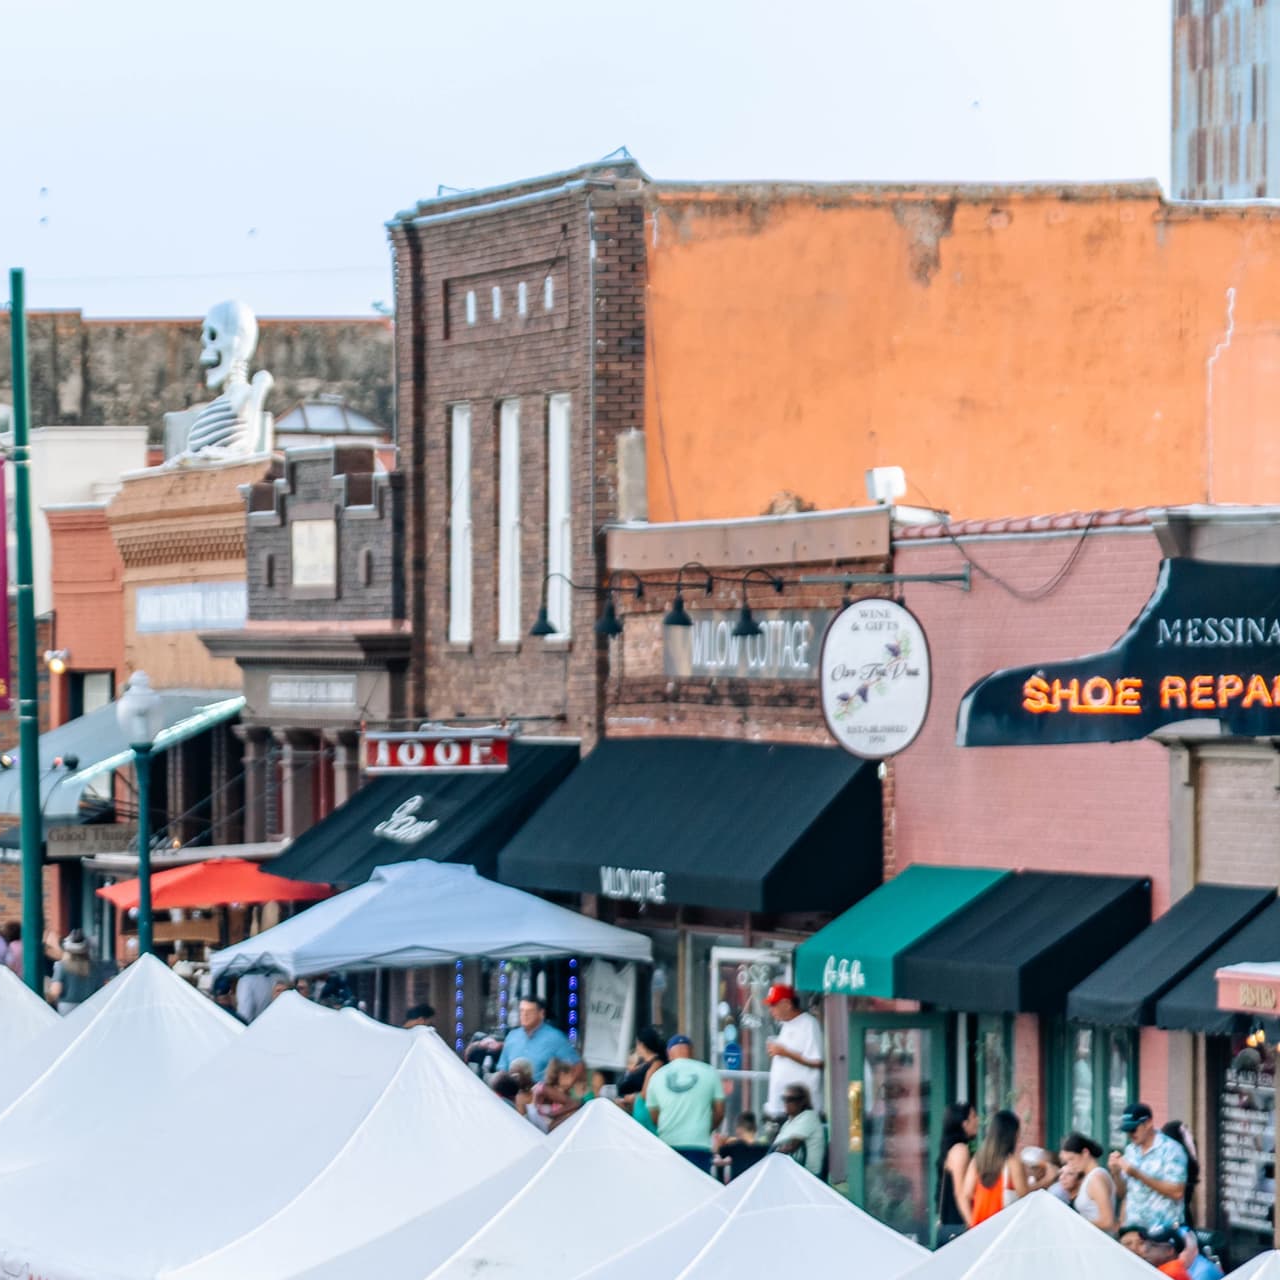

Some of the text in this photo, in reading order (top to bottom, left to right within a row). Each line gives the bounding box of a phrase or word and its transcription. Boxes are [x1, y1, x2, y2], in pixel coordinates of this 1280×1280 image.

[858, 608, 891, 619] WINE
[864, 620, 900, 632] GIFTS
[690, 620, 811, 669] WILLOW COTTAGE
[1022, 672, 1143, 714] SHOE
[375, 739, 496, 766] IOOF
[1240, 983, 1277, 1009] BISTRO
